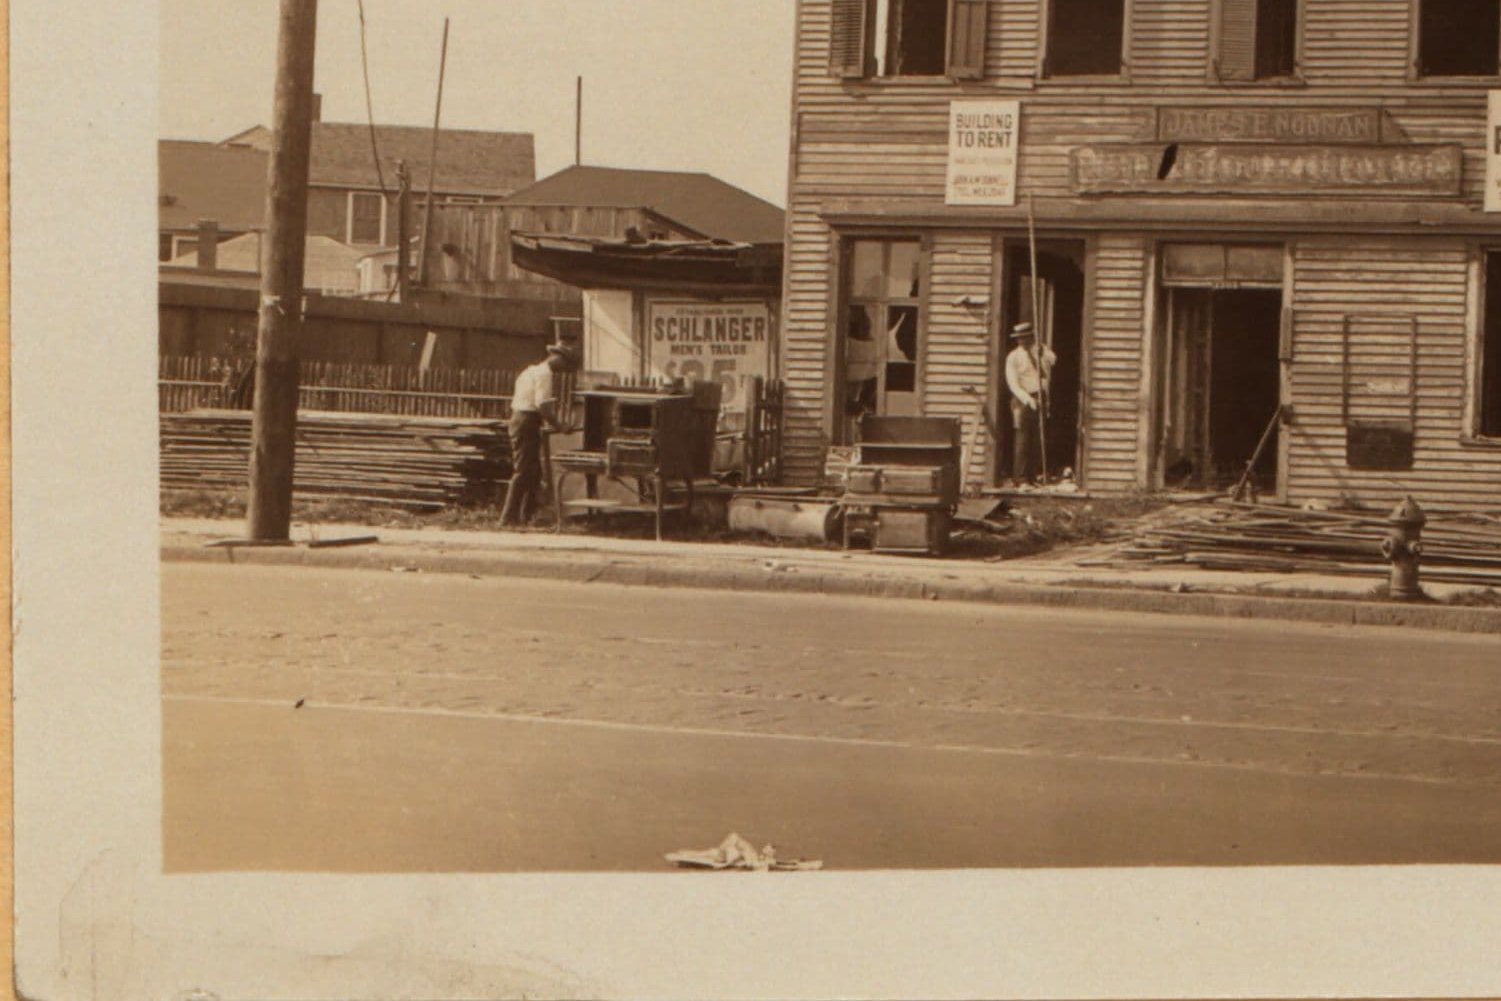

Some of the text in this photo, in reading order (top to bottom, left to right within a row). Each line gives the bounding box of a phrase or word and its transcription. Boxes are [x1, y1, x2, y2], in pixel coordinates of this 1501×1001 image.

[956, 113, 1012, 129] BUILDING
[956, 130, 1012, 148] TO RENT
[654, 317, 765, 342] SCHLANGER
[710, 344, 747, 356] TAILOR
